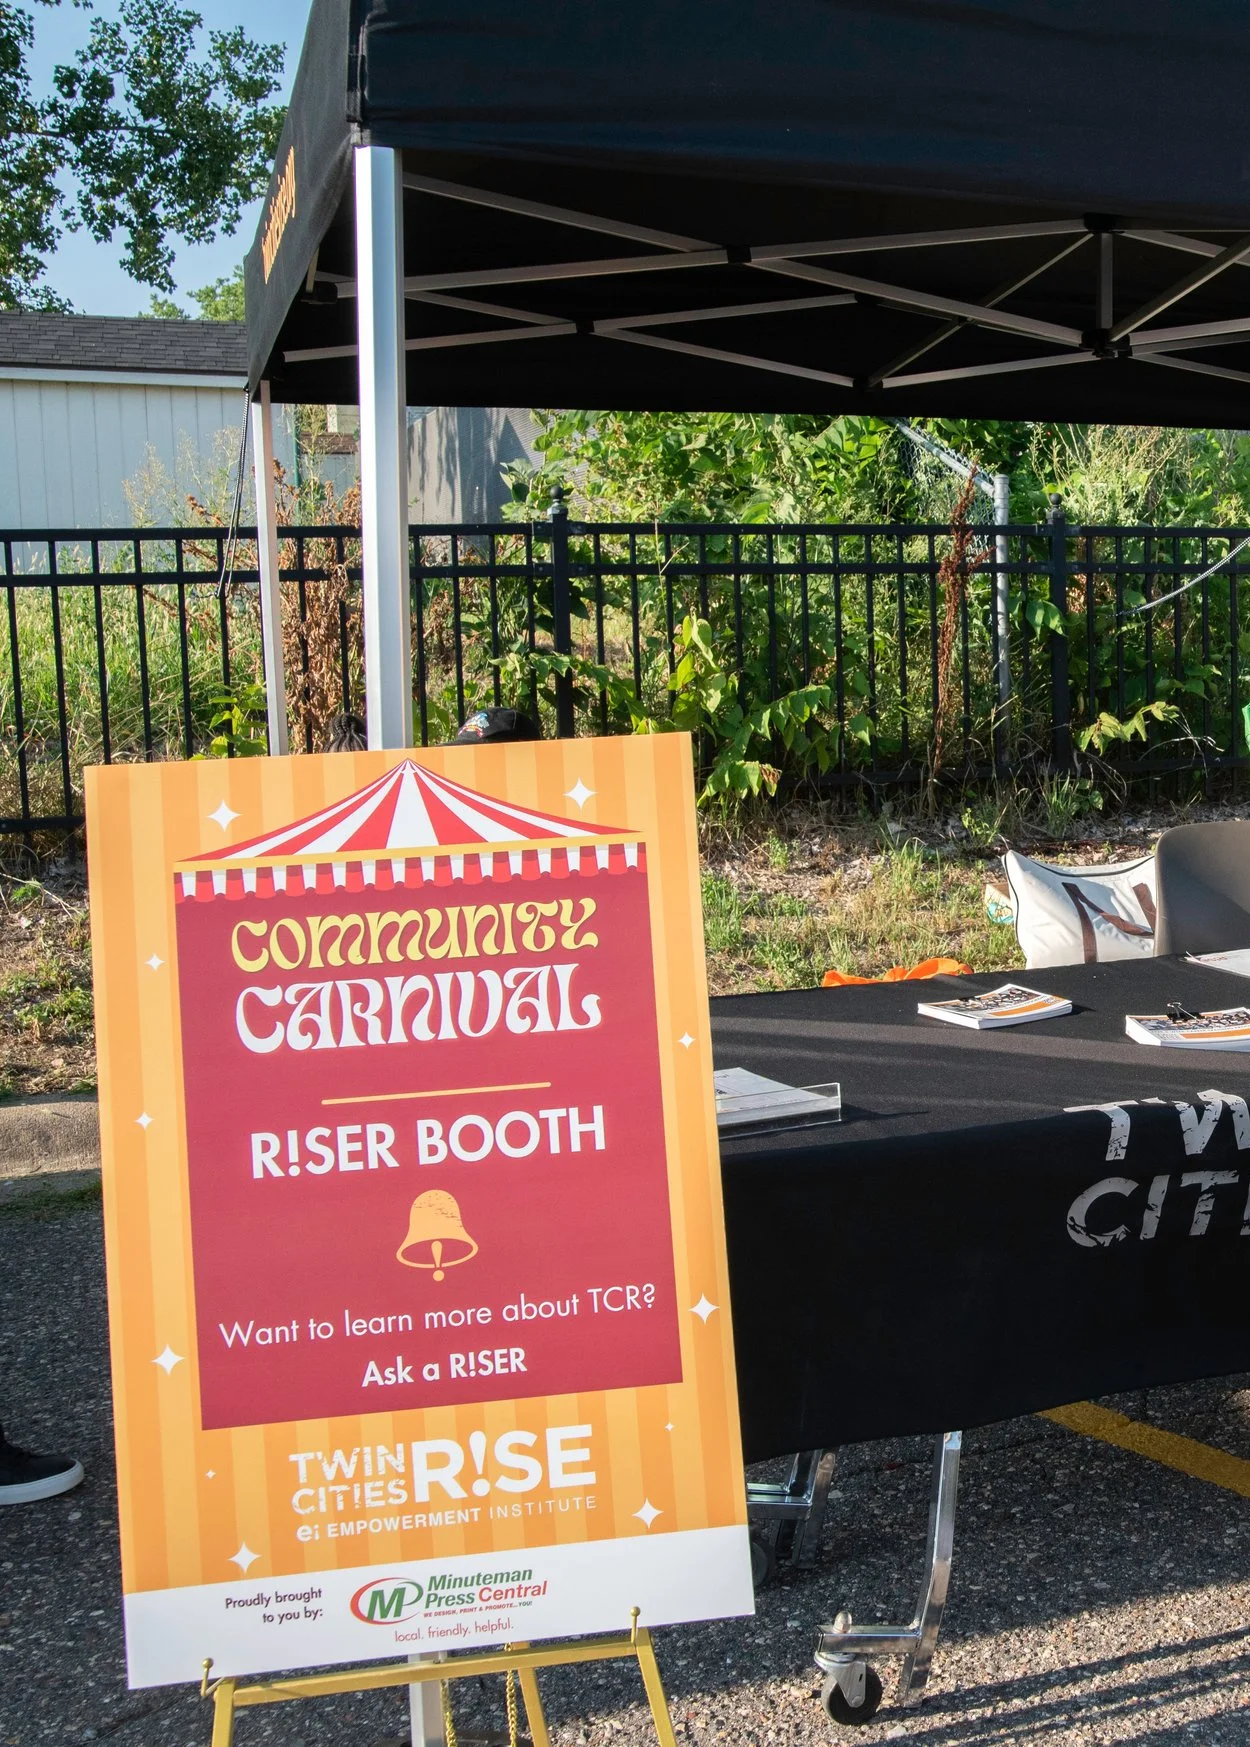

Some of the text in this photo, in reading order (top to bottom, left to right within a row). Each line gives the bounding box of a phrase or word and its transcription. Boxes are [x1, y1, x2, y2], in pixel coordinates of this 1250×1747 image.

[231, 898, 599, 973] COMMUNITY
[236, 963, 602, 1053] CARNIVAL
[250, 1105, 606, 1179] R!SER BOOTH
[219, 1283, 656, 1349] Want to learn more about TCR?
[361, 1347, 527, 1388] Ask a R!SER
[288, 1443, 405, 1484] TWIN
[411, 1424, 597, 1503] R!SE
[327, 1508, 481, 1538] EMPOWERMENT
[489, 1496, 597, 1519] INSTITUTE
[225, 1587, 322, 1608] Proudly brought
[425, 1581, 548, 1609] Press Central
[427, 1569, 533, 1592] Minuteman
[262, 1606, 323, 1624] to you by:
[395, 1617, 514, 1642] local. friendly. helpful.
